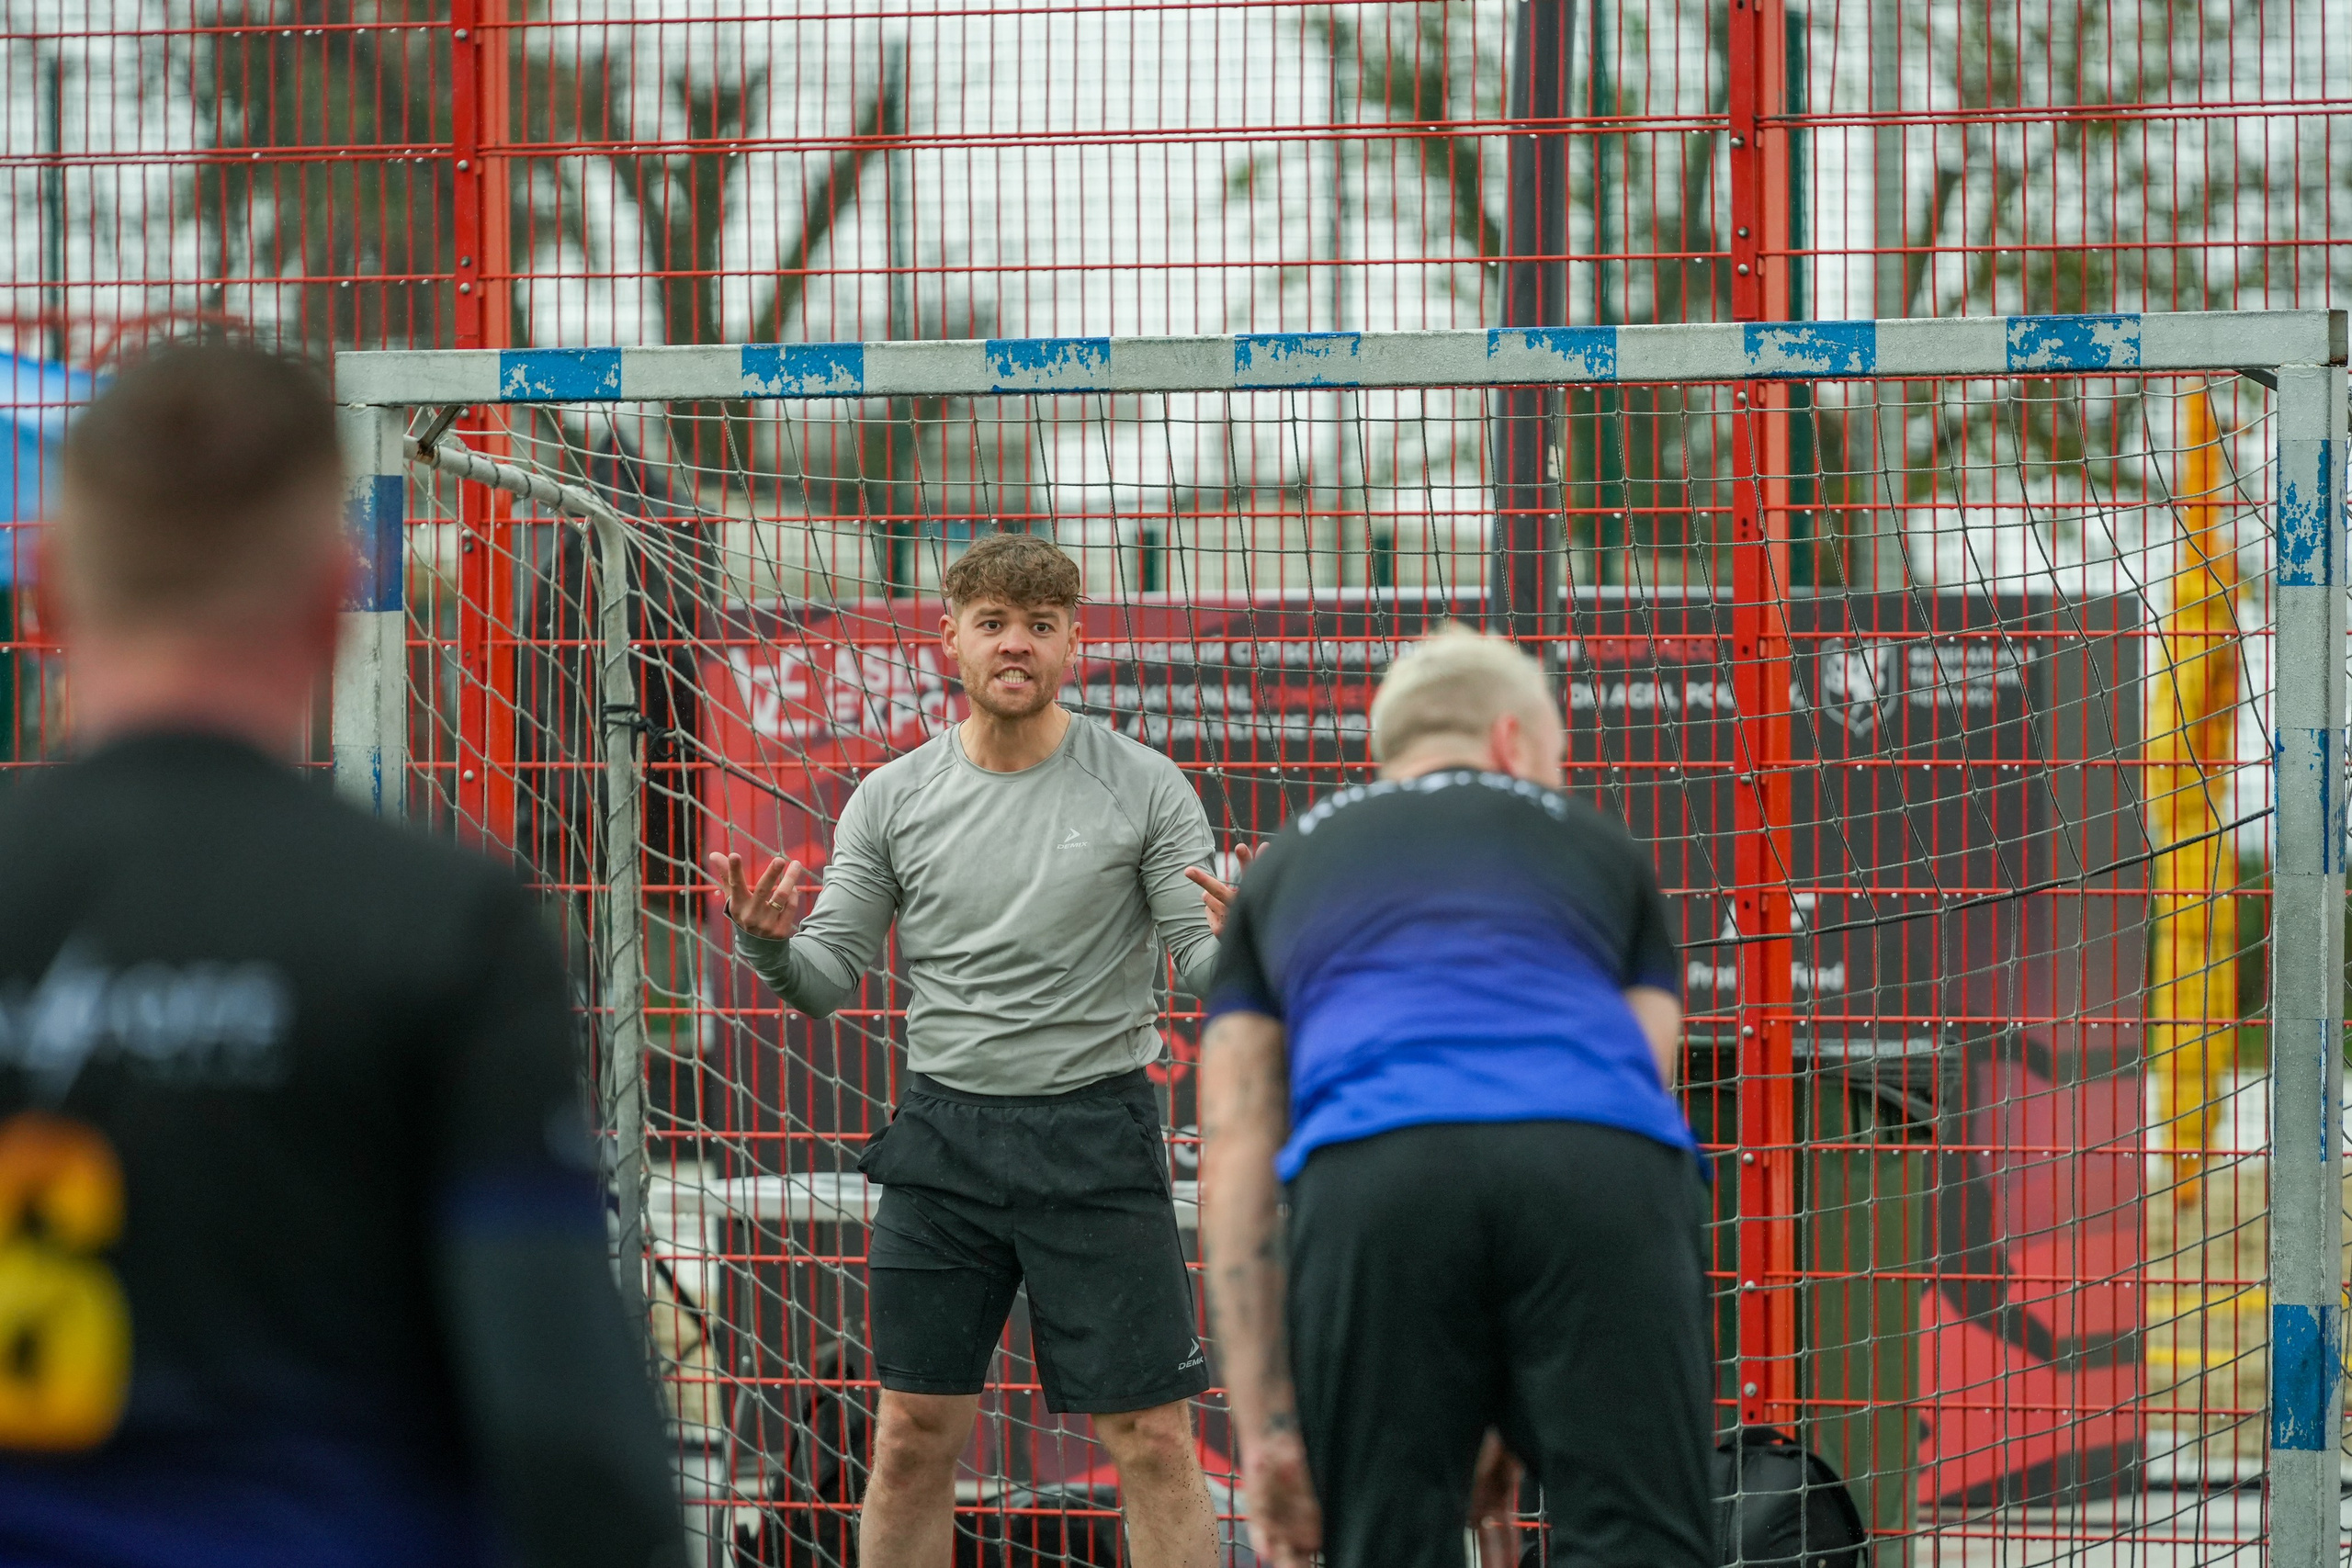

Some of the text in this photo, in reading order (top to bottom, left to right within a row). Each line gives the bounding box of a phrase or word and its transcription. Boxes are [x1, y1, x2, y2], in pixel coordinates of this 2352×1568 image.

[825, 646, 943, 691] ASIA
[826, 692, 957, 738] EXPO
[1057, 840, 1088, 850] DEMIX
